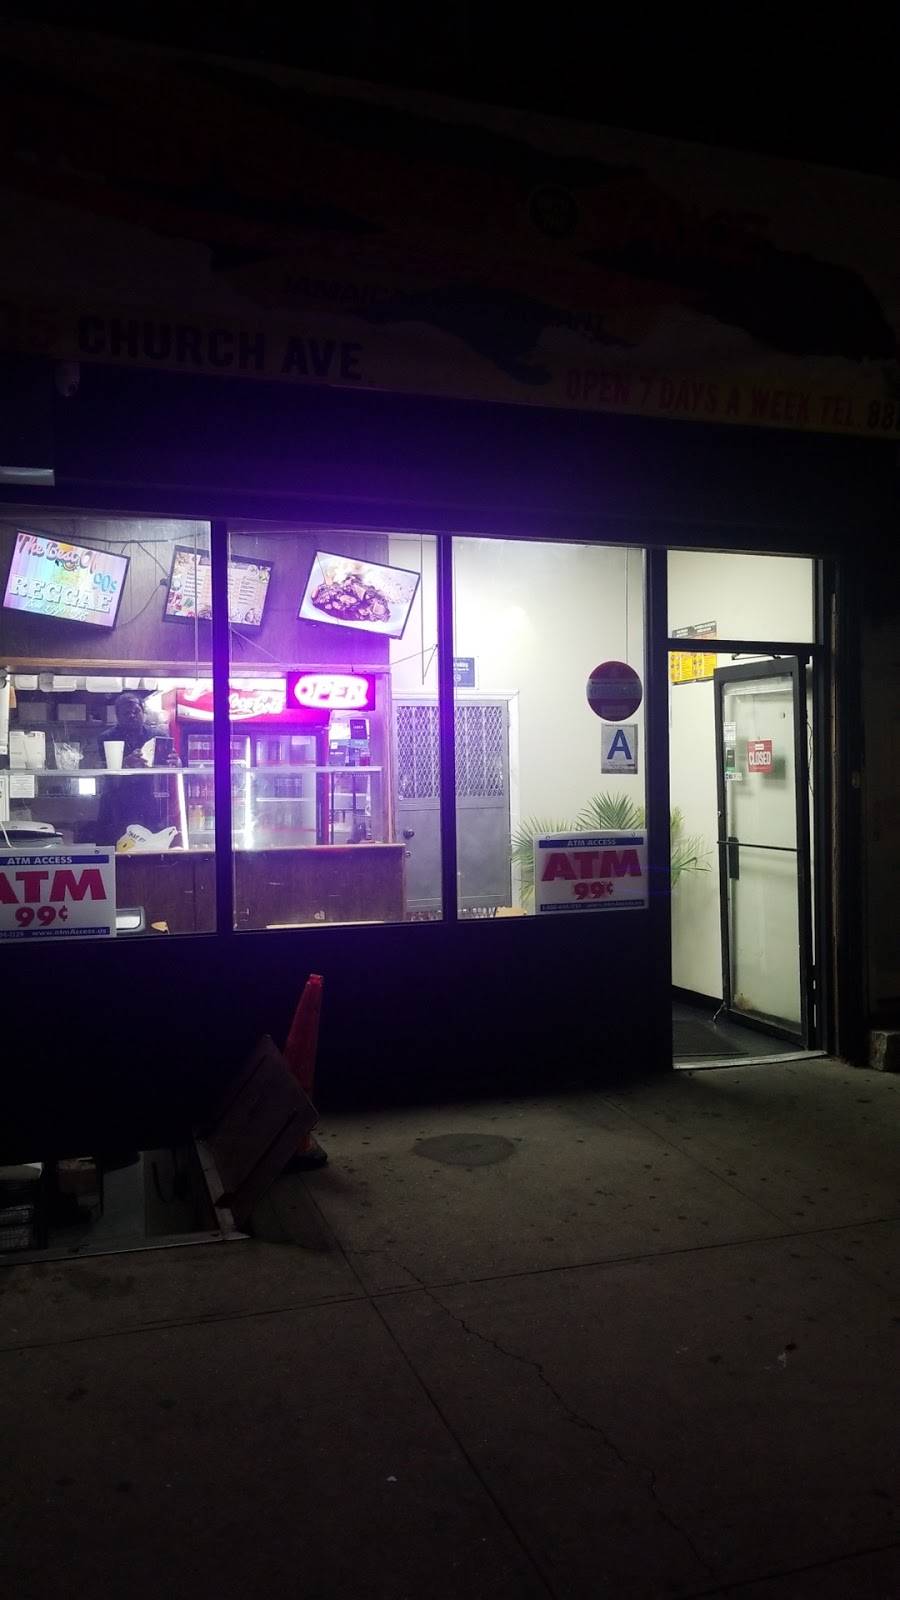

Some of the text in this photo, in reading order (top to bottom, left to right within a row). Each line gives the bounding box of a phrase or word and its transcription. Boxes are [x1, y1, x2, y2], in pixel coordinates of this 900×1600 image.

[77, 315, 266, 370] CHURCH
[281, 335, 364, 382] AVE
[565, 368, 633, 404] OPEN
[640, 376, 656, 408] 7
[657, 378, 720, 415] DAYS
[726, 384, 742, 418] A
[750, 388, 812, 425] WEEK
[17, 533, 45, 558] The
[46, 540, 80, 565] Best
[8, 575, 114, 614] REGGAE
[292, 674, 370, 710] OPEN
[606, 728, 634, 760] A
[748, 751, 772, 766] CLOSED
[7, 856, 73, 865] ATM ACCESS
[541, 849, 642, 882] ATM
